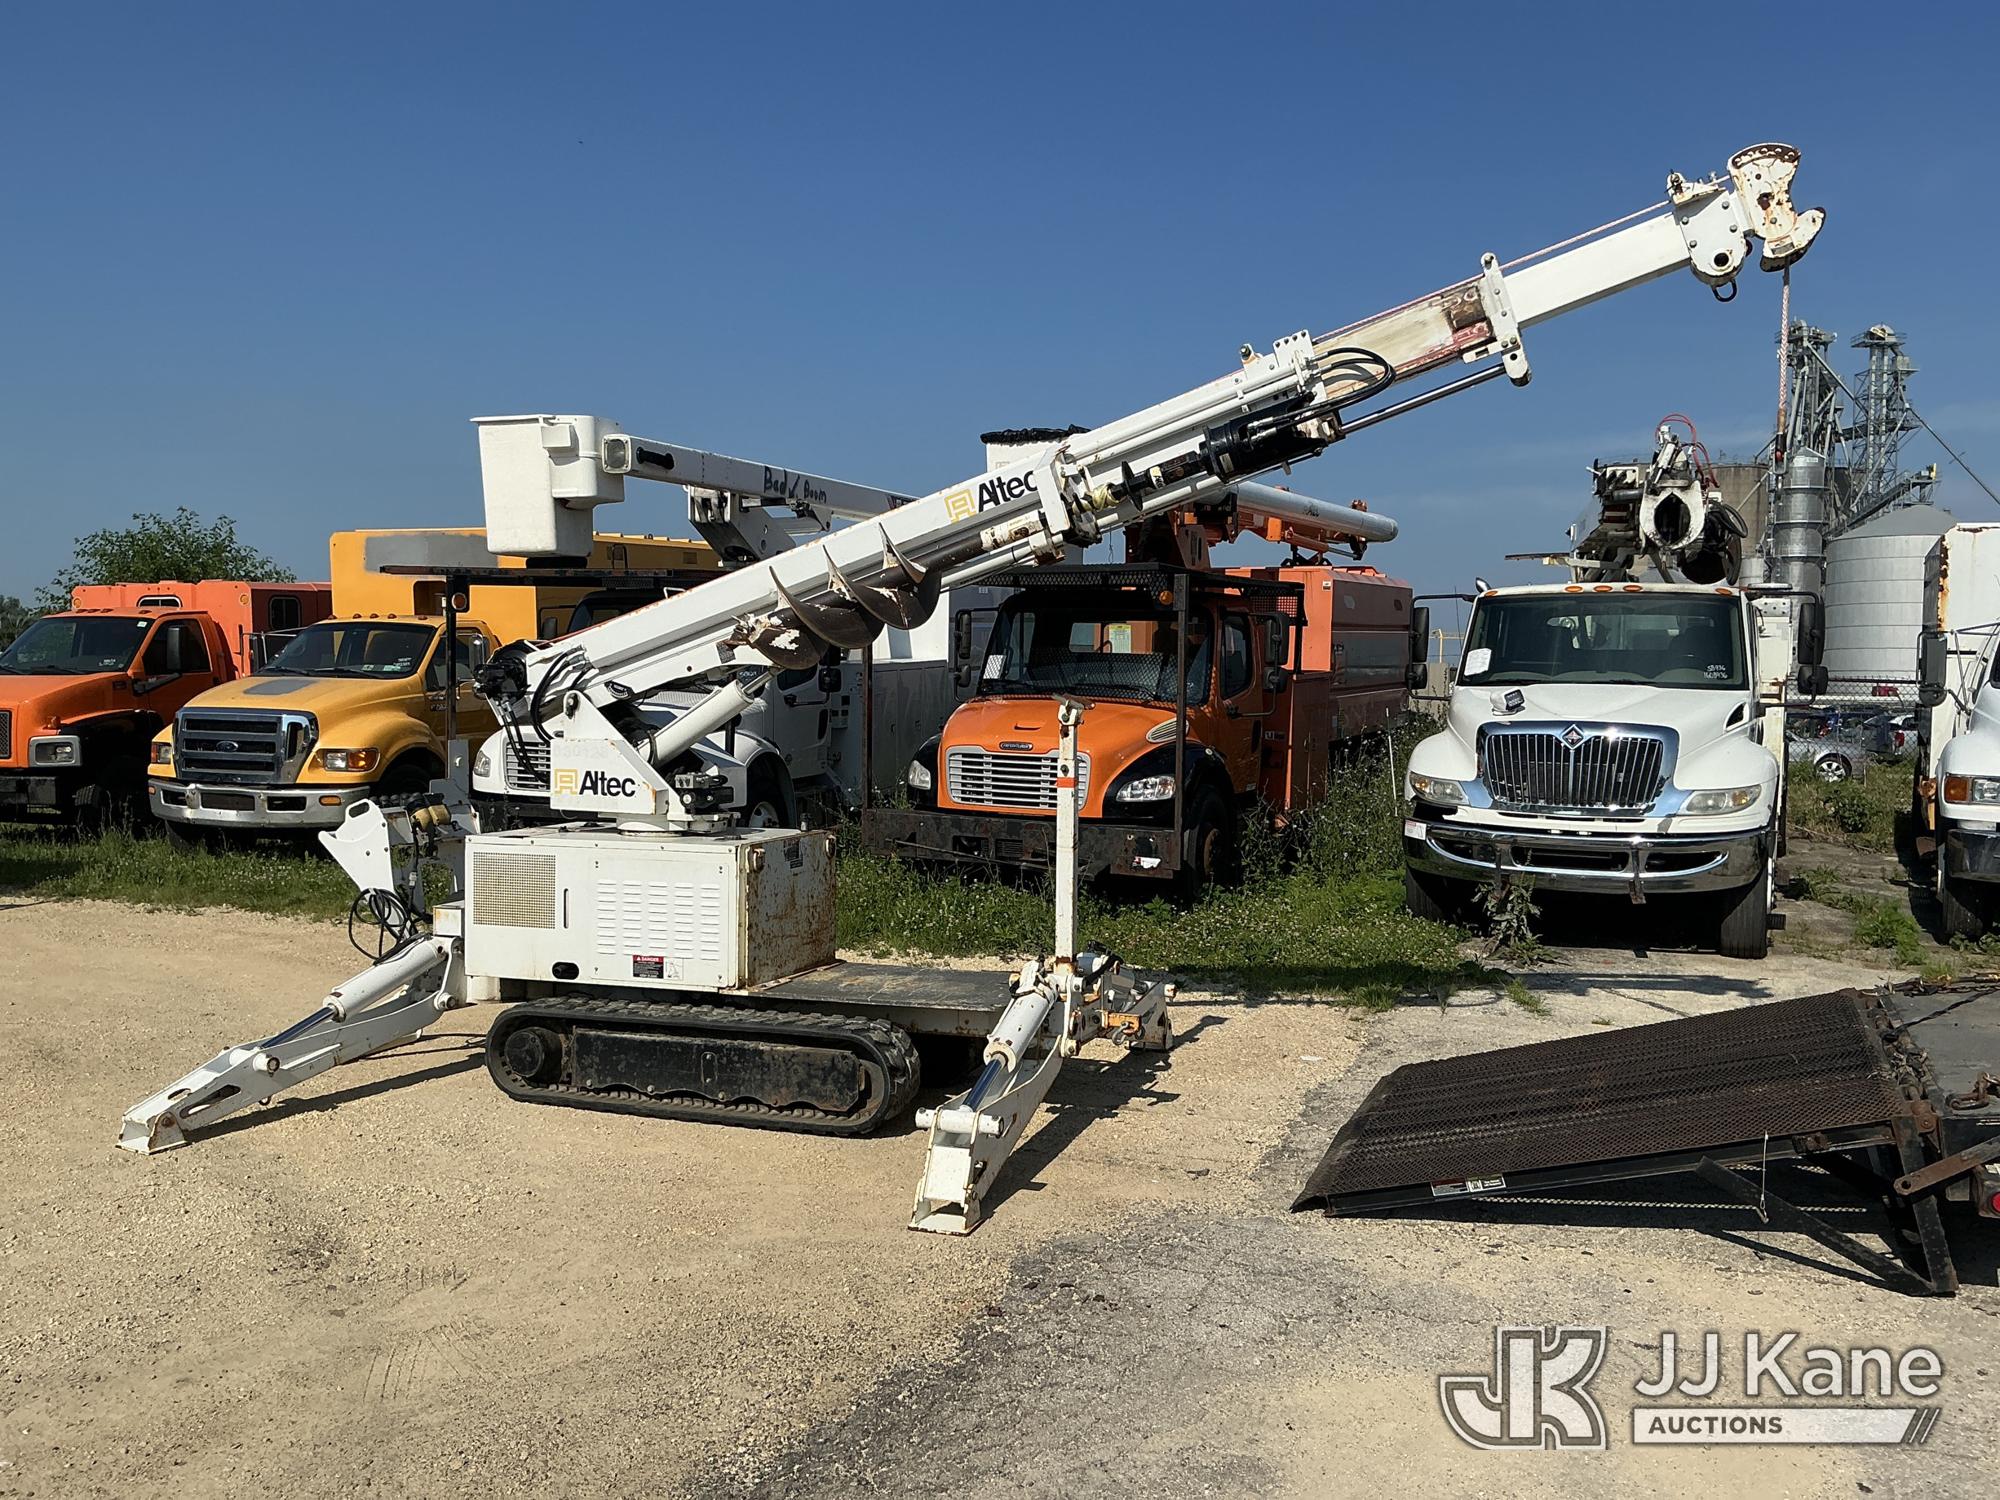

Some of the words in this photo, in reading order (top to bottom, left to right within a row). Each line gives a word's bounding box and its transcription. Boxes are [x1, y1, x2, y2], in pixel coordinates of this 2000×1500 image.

[764, 465, 787, 495] Bad
[803, 479, 827, 504] Boom
[979, 470, 1038, 513] Altec
[579, 770, 636, 797] Altec
